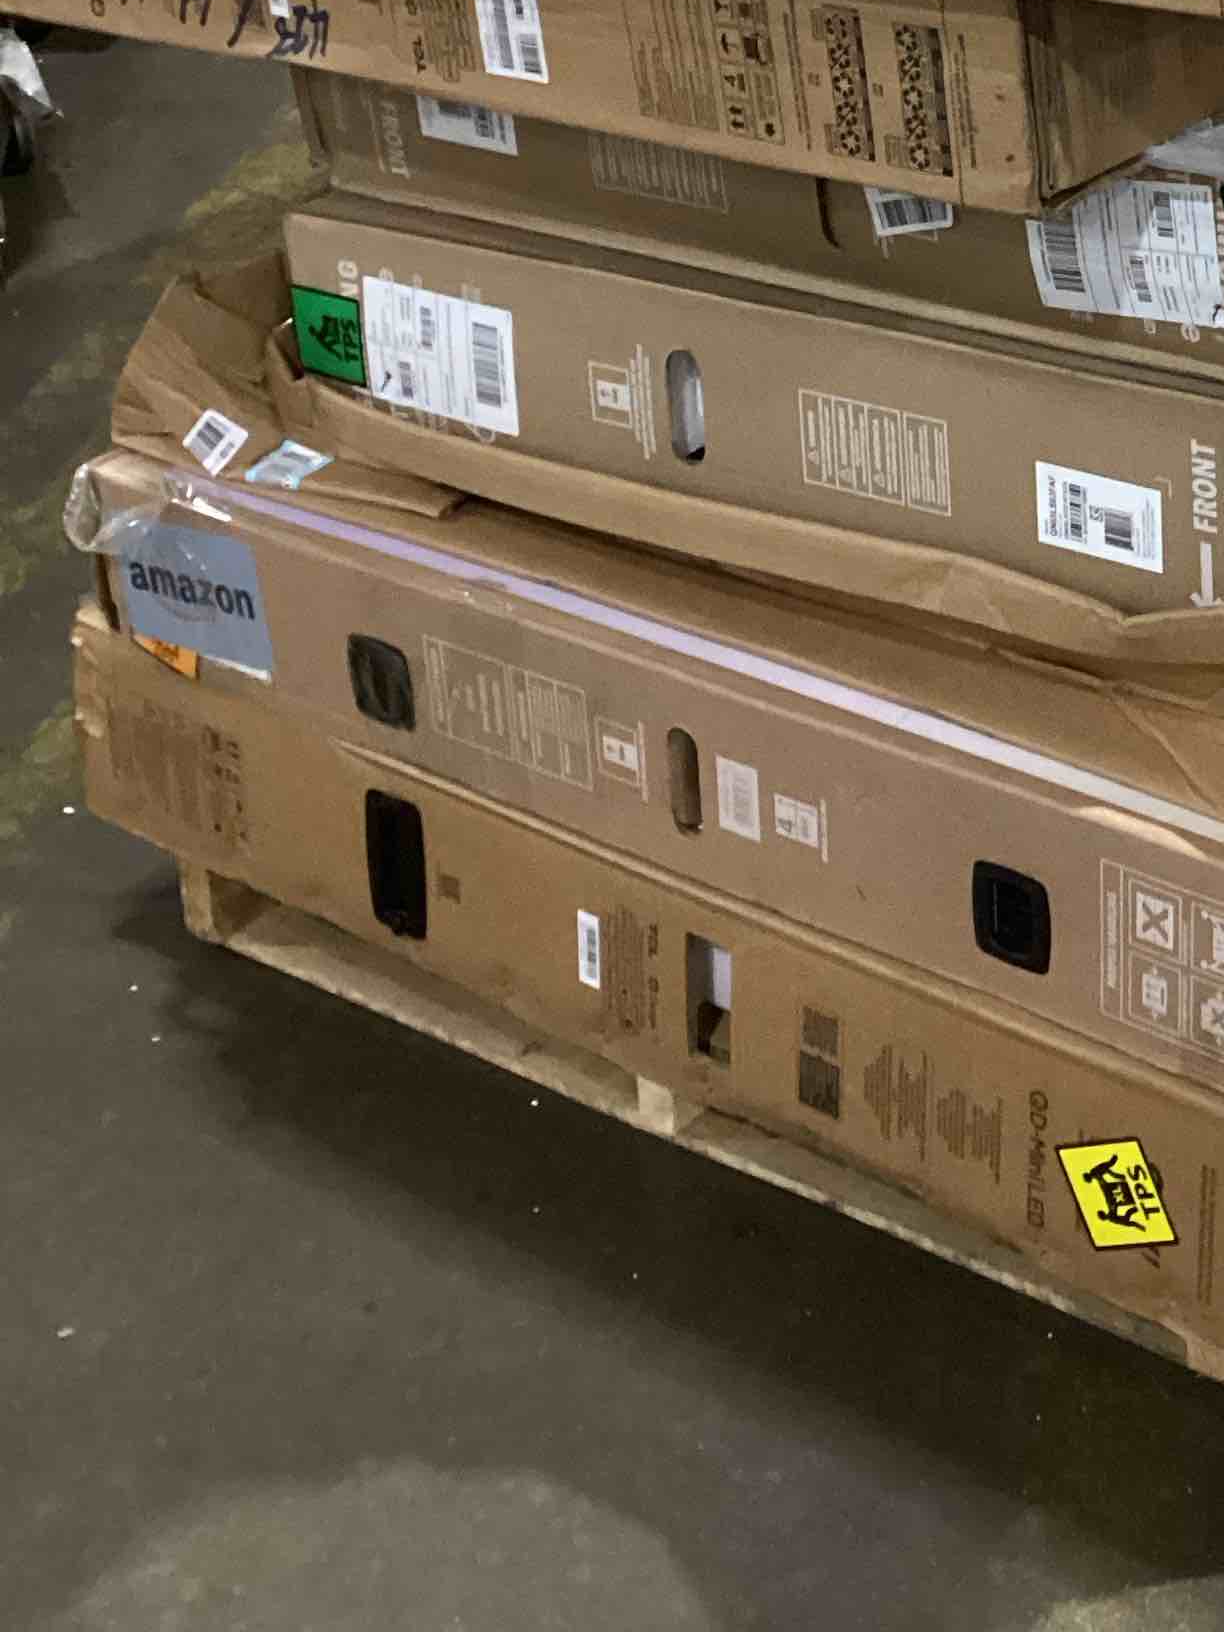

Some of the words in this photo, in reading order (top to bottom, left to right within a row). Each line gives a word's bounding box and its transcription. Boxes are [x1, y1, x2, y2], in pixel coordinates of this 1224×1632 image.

[339, 318, 363, 366] TPS
[1191, 439, 1217, 534] FRONT
[129, 560, 256, 621] amazon
[1127, 1165, 1162, 1220] TPS
